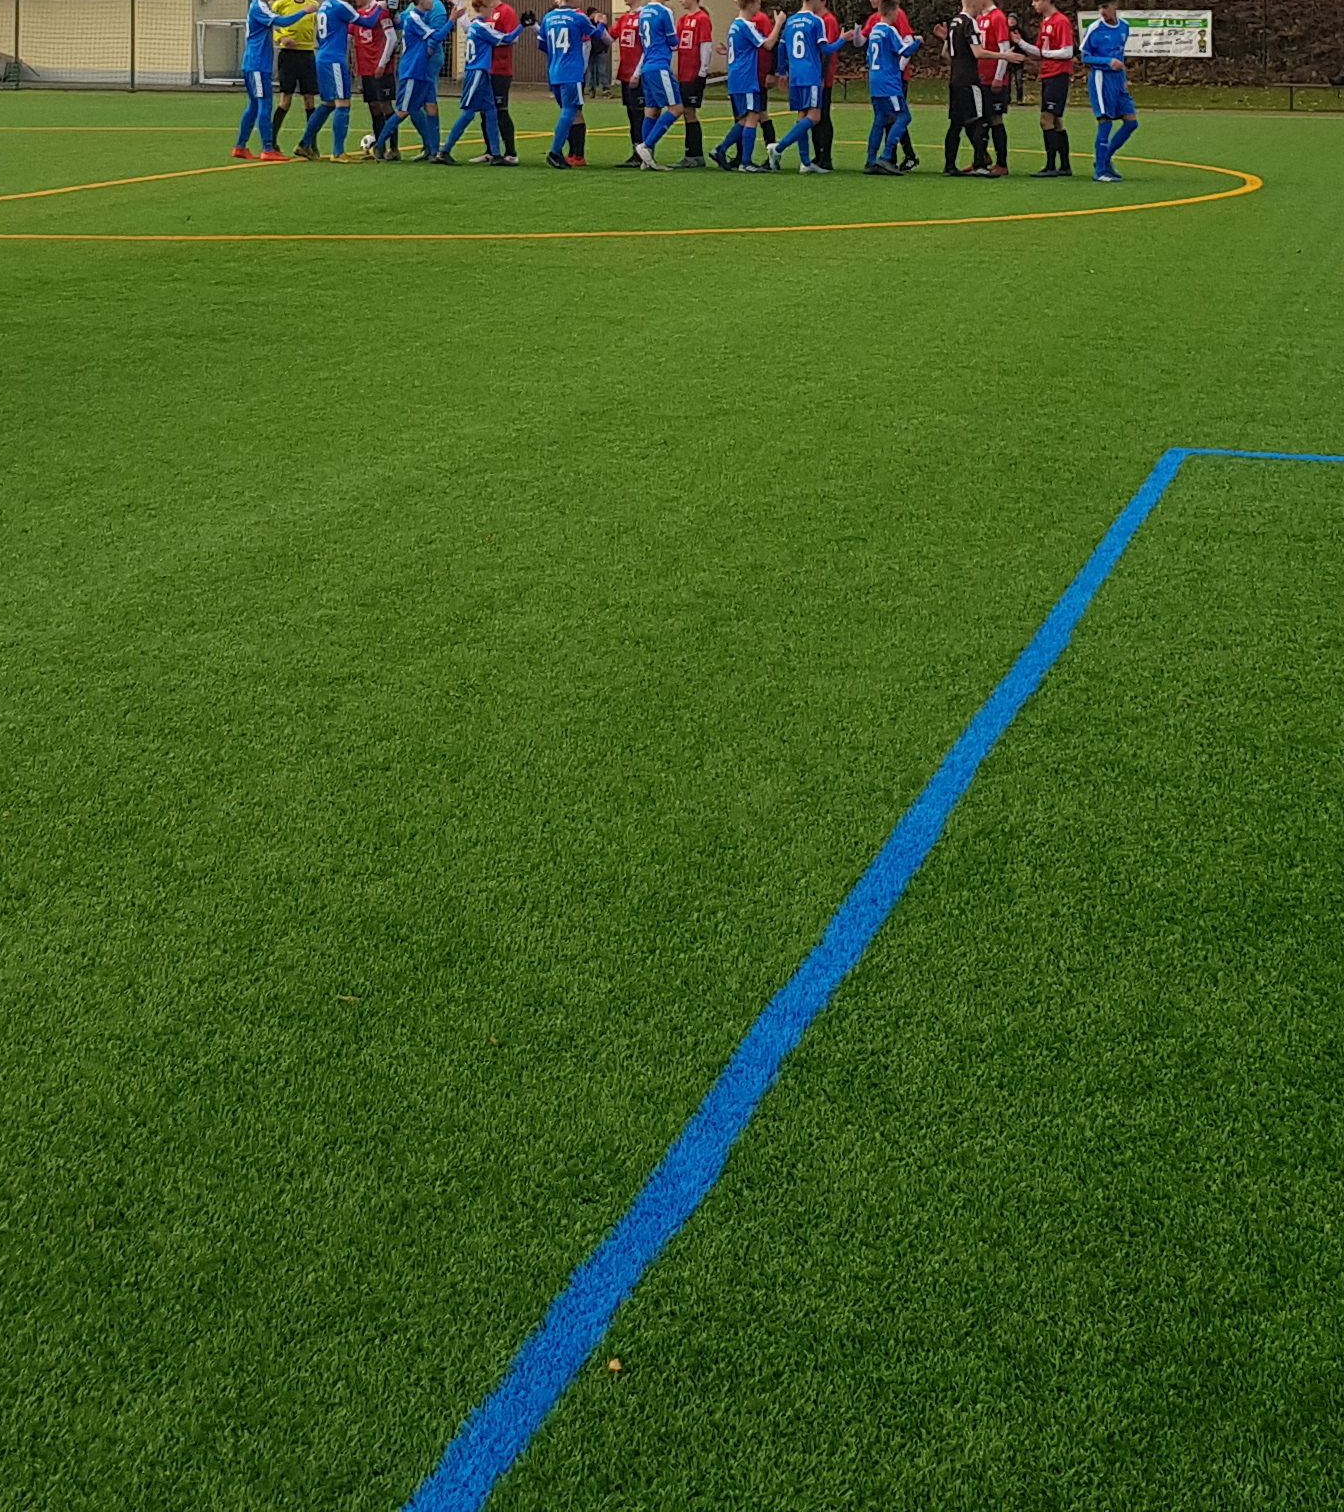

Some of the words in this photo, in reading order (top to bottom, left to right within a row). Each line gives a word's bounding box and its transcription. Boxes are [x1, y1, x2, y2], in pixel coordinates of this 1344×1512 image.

[317, 12, 327, 39] 9
[642, 20, 651, 48] 3
[547, 27, 571, 54] 14
[792, 30, 806, 59] 6
[871, 42, 881, 70] 2
